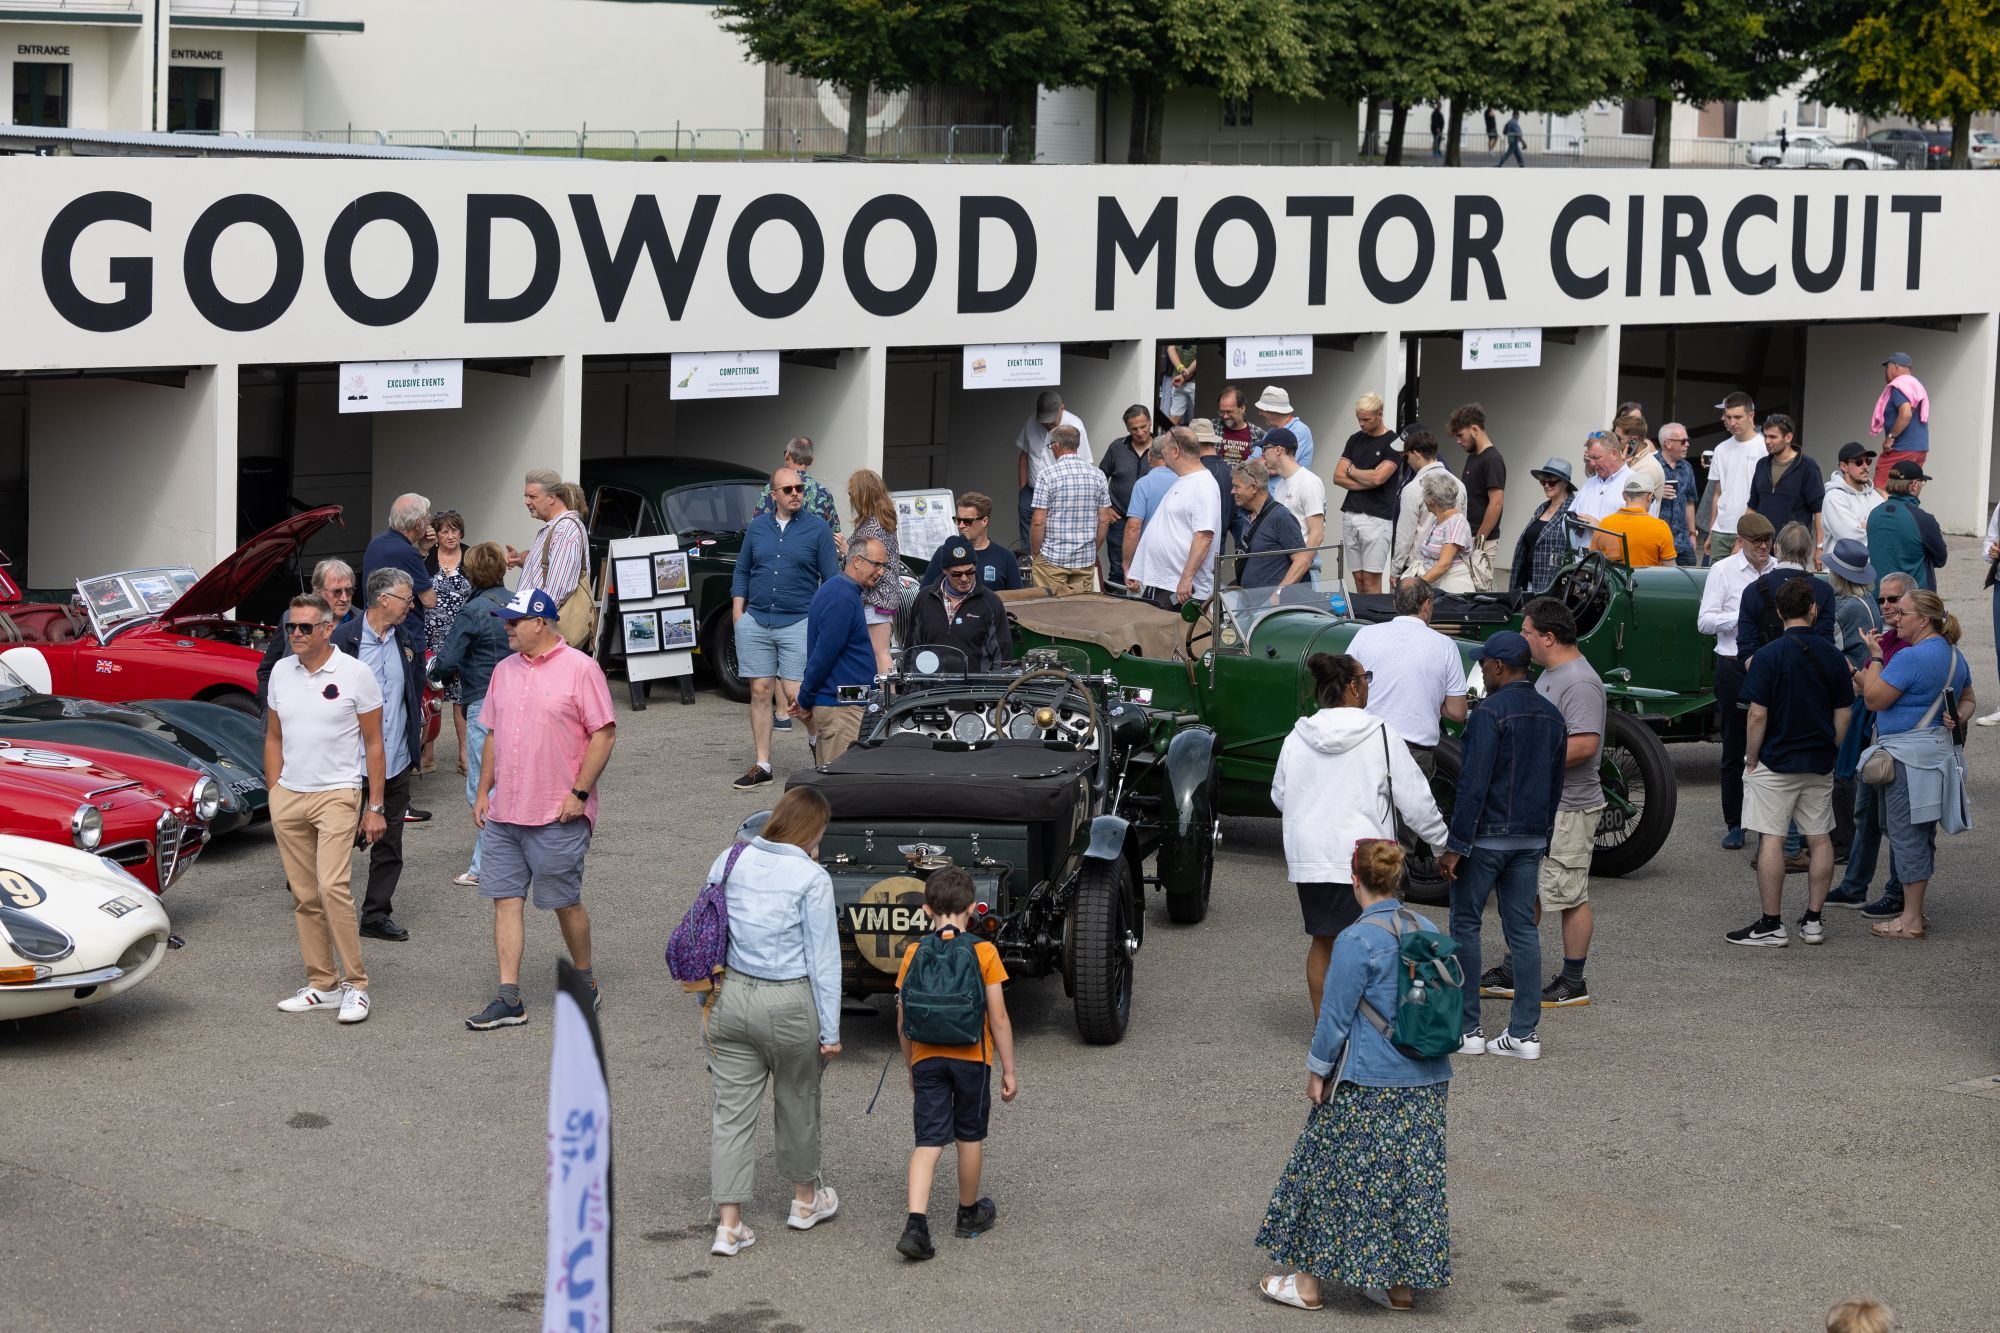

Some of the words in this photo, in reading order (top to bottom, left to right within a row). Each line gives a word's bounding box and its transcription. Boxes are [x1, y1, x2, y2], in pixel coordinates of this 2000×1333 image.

[18, 44, 70, 56] ENTRANCE
[171, 49, 223, 60] ENTRANCE
[41, 190, 1038, 333] GOODWOOD
[1094, 193, 1507, 311] MOTOR
[1549, 193, 1941, 300] CIRCUIT
[1007, 359, 1023, 367] EVENT
[1023, 358, 1044, 367] TICKETS
[719, 366, 760, 377] COMPETITIONS
[387, 378, 421, 389] EXCLUSIVE
[421, 377, 445, 387] EVENTS
